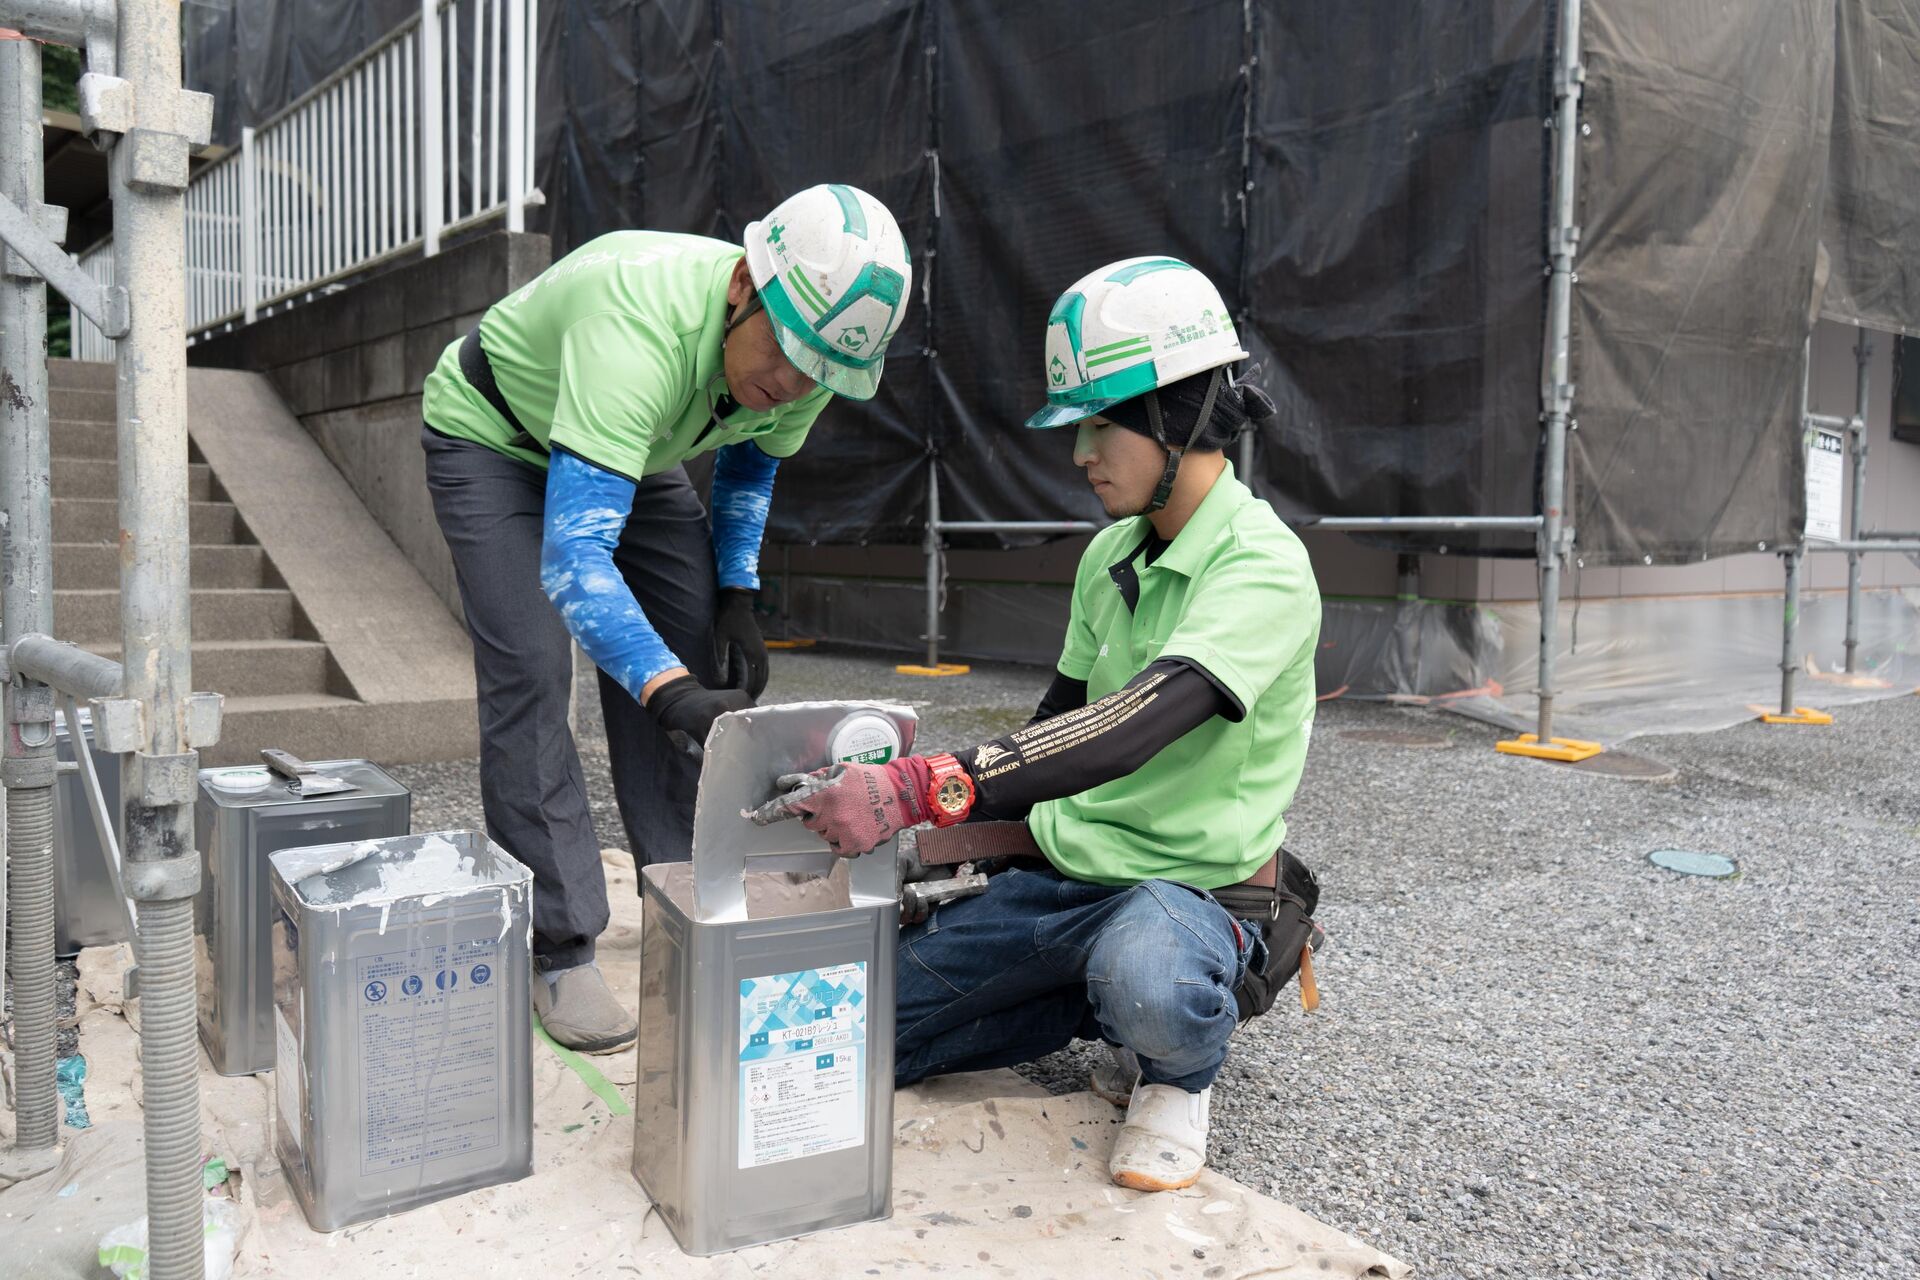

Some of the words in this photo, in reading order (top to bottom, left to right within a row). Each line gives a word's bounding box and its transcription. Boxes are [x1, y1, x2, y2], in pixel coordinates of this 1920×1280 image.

[1014, 734, 1029, 744] THE
[1027, 719, 1068, 738] CONFIDENCE
[1067, 707, 1097, 724] CHANGES
[1020, 724, 1041, 735] GOING
[1037, 735, 1052, 744] BRAND
[1040, 741, 1055, 751] BRAND
[977, 760, 1021, 781] Z-DRAGON
